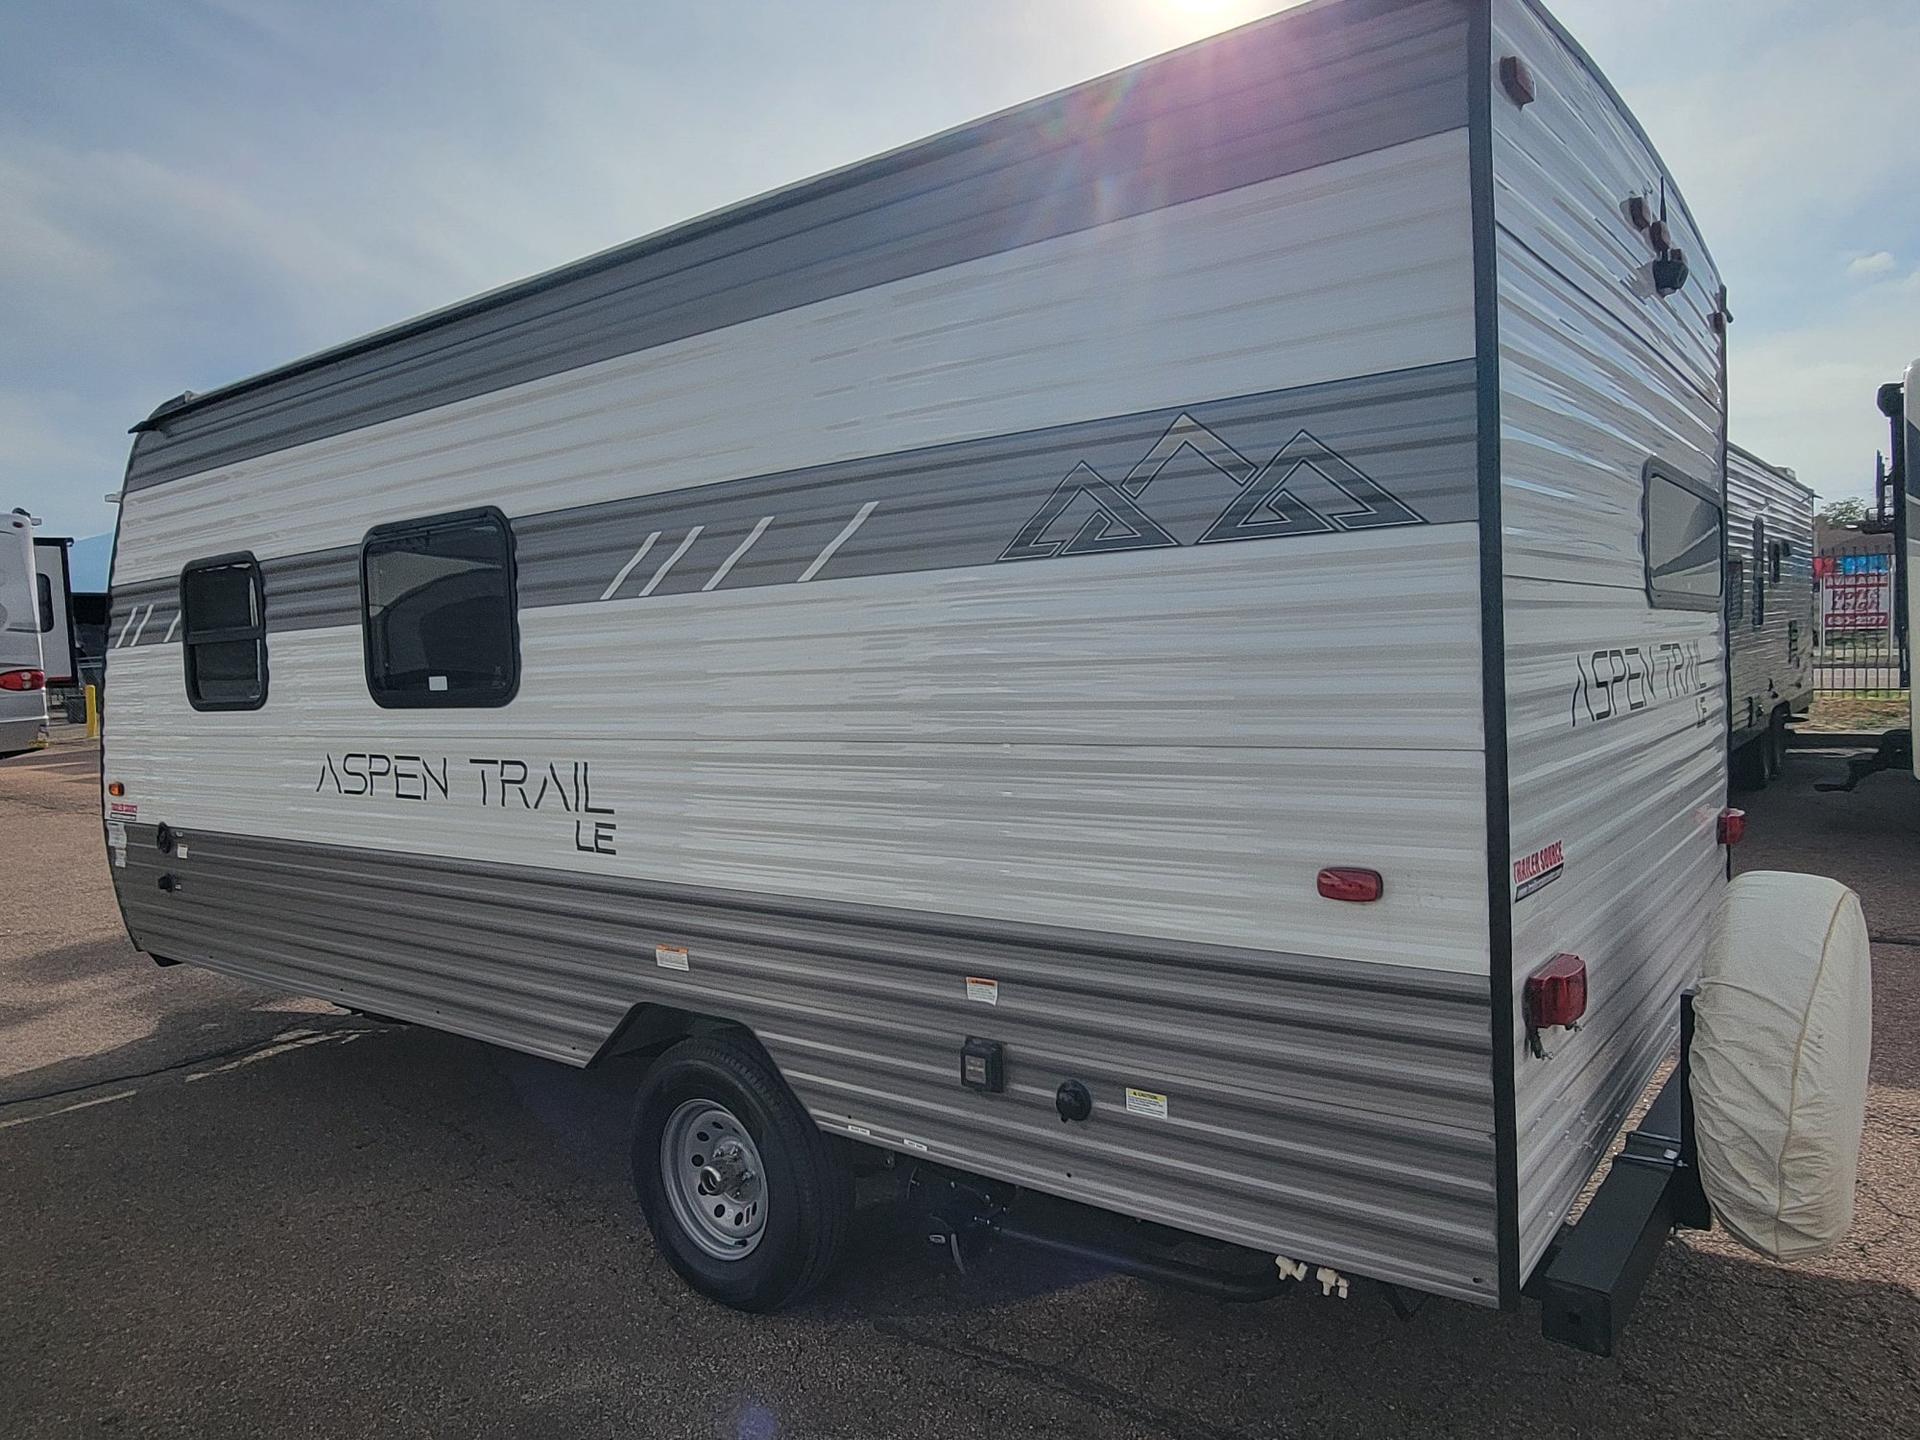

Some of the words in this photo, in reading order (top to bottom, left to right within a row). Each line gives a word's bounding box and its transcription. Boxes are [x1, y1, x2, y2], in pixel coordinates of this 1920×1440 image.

[1571, 645, 1657, 728] ASPEN
[315, 752, 449, 801] ASPEN
[468, 757, 615, 815] TRAIL
[574, 819, 617, 856] LE
[1513, 851, 1541, 884] TRAILER
